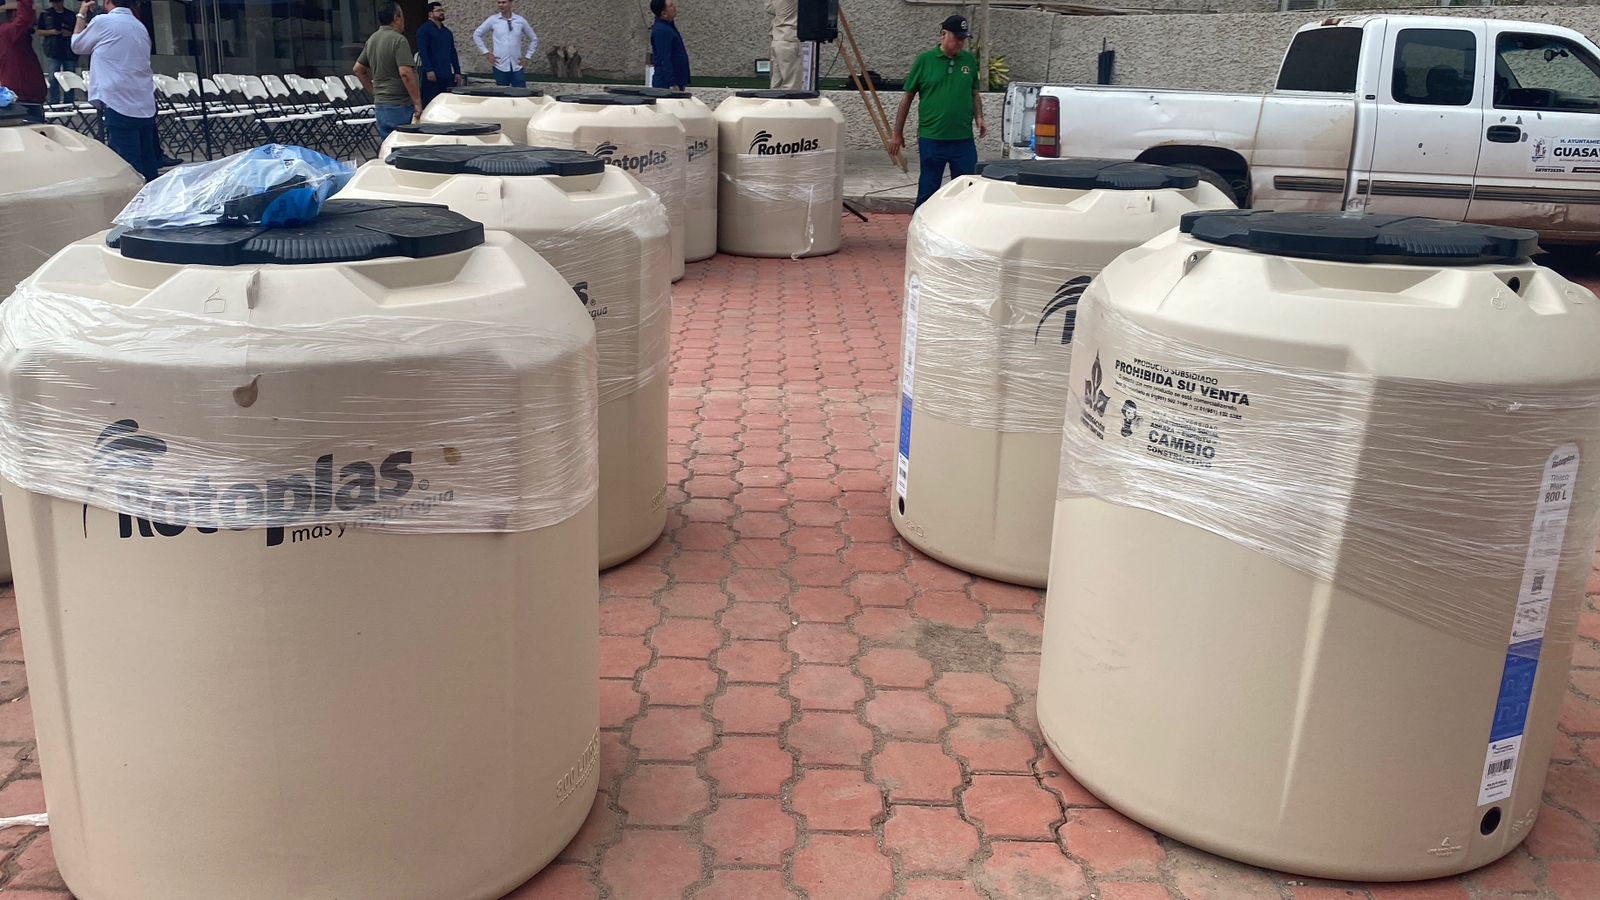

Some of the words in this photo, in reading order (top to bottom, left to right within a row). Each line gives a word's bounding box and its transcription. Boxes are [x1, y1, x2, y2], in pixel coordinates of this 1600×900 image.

[758, 138, 819, 158] Rotoplas
[1115, 359, 1173, 388] PROHIBIDA
[1177, 379, 1196, 393] SU
[1200, 385, 1250, 406] VENTA
[1134, 357, 1169, 373] PRODUCTO
[1170, 367, 1219, 386] SUBSIDIADO
[1148, 430, 1216, 459] CAMBIO
[118, 451, 414, 547] Rotoplas
[1544, 491, 1561, 503] 800
